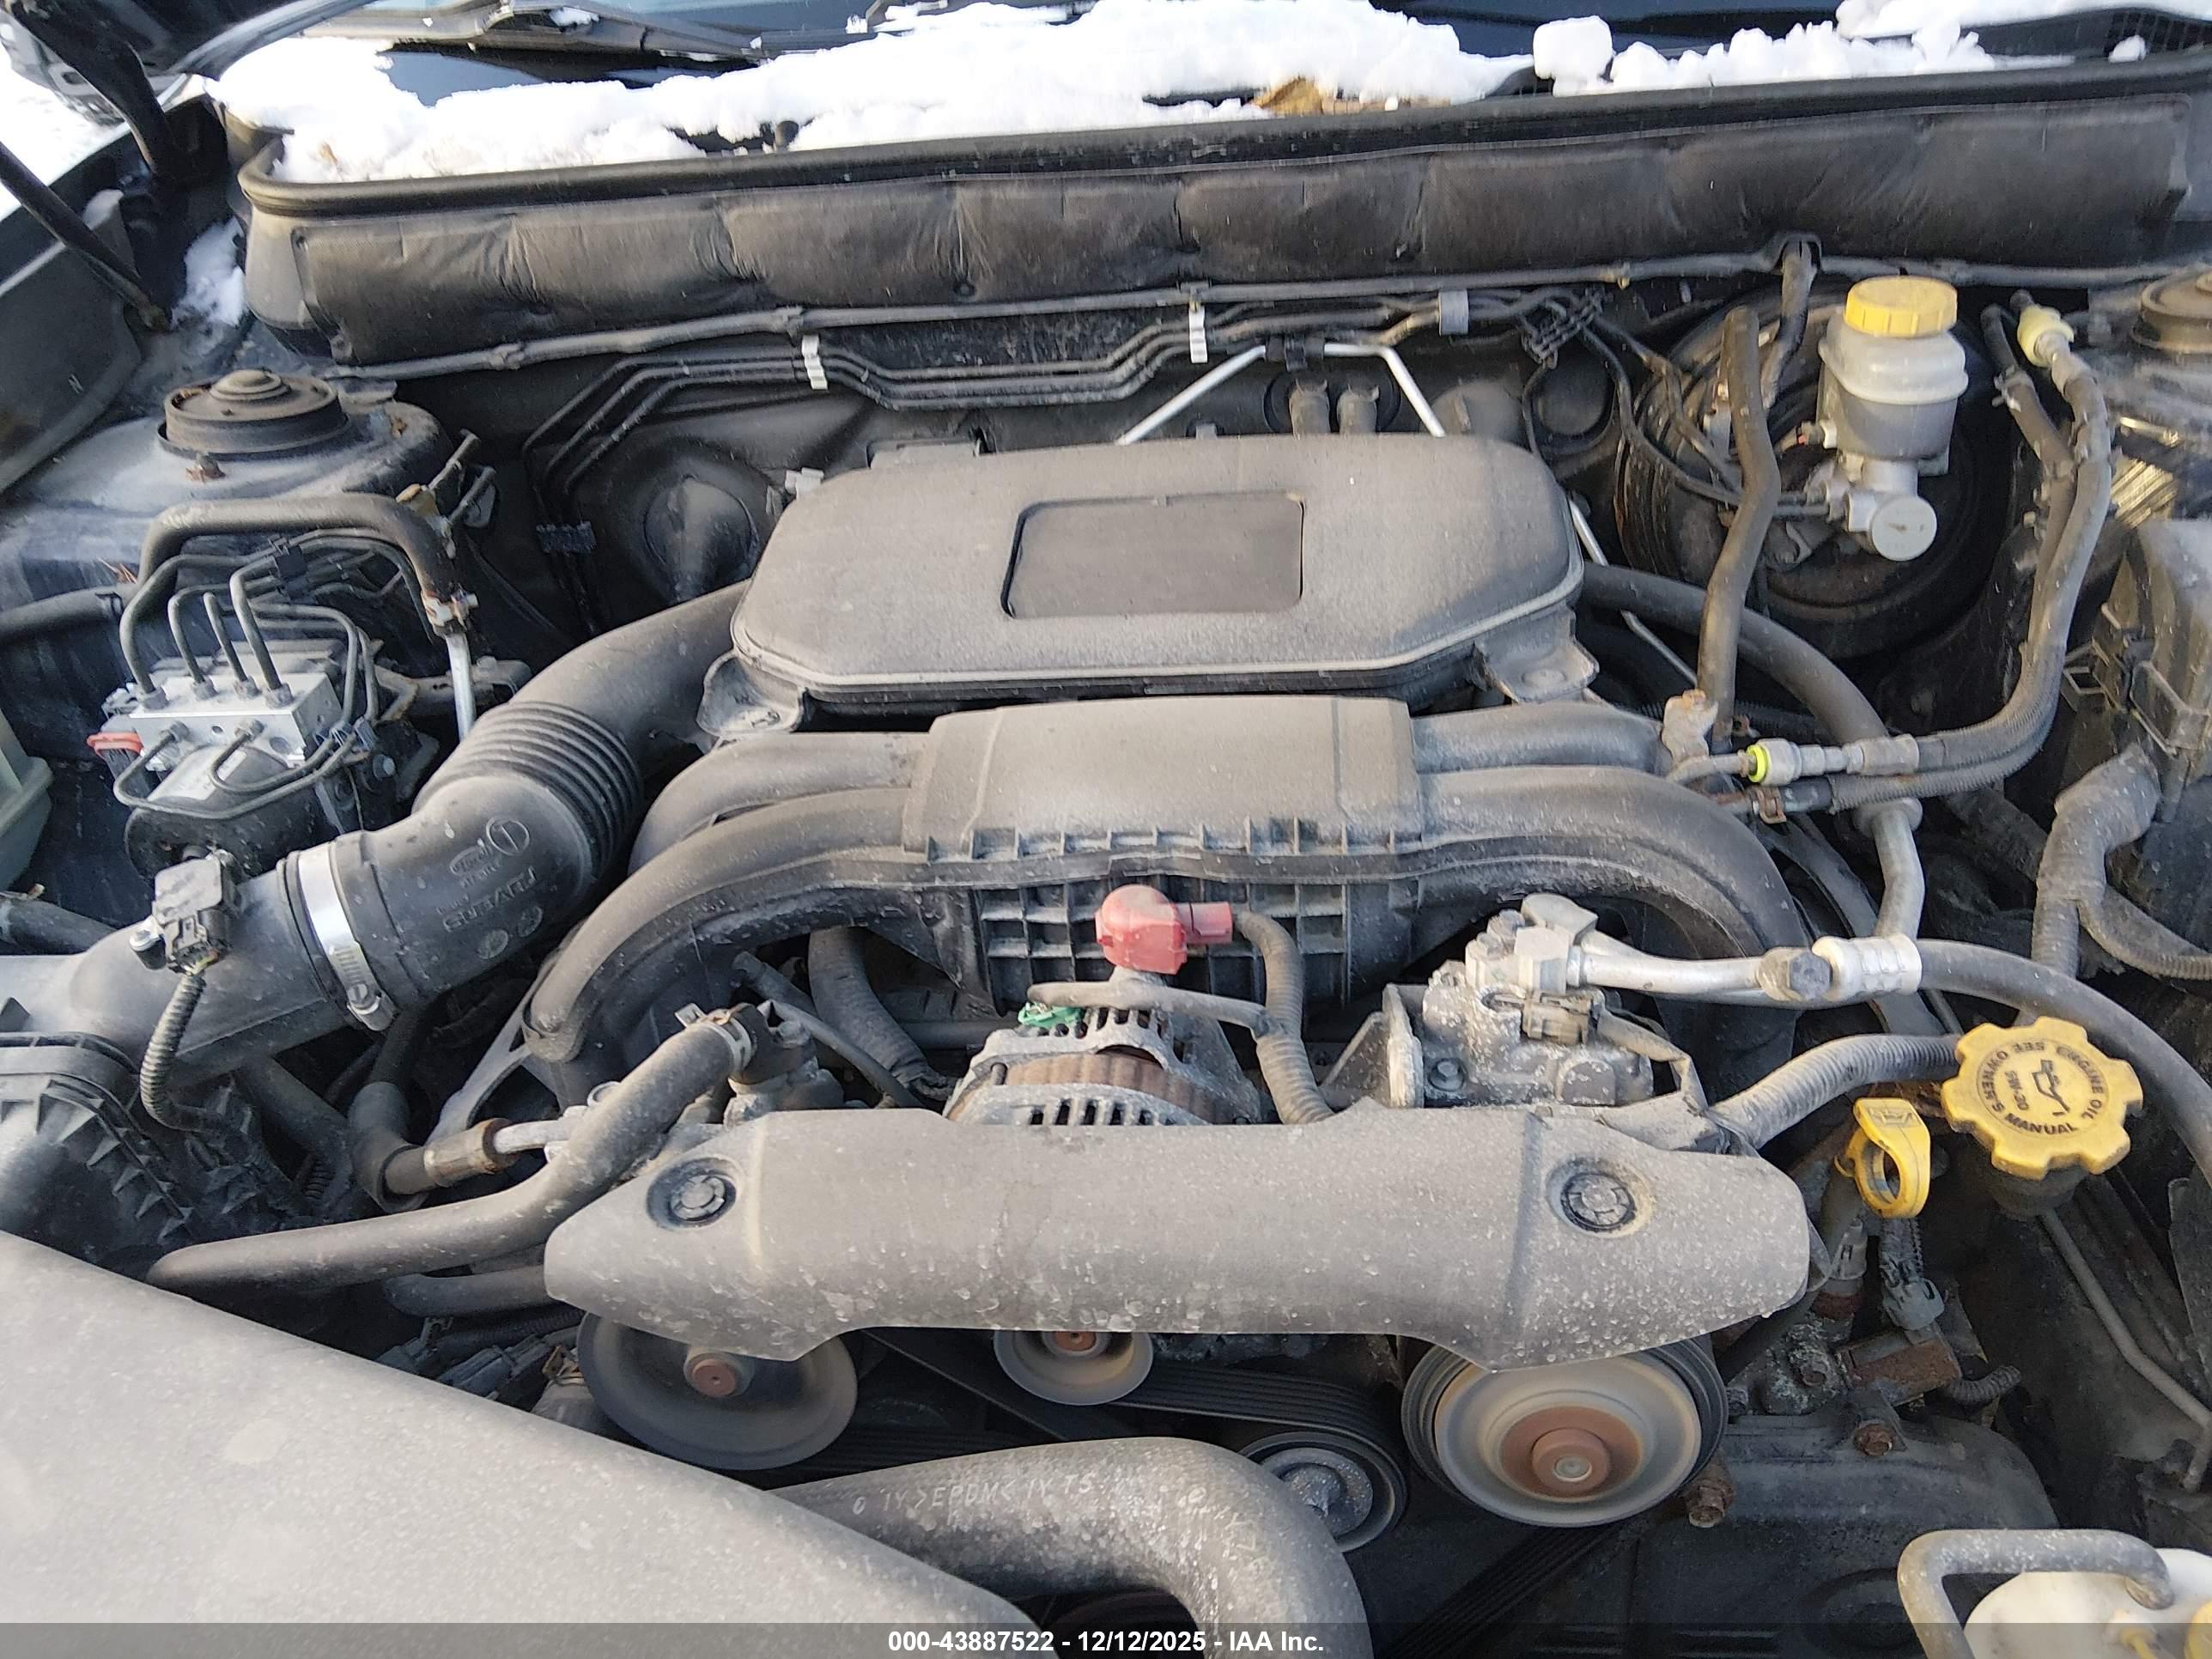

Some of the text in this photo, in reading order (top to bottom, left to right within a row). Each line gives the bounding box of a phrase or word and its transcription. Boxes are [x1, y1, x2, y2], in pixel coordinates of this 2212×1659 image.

[2012, 1042, 2045, 1054] SEE
[2057, 1045, 2104, 1120] ENGINE OIL
[2004, 1112, 2079, 1135] MANUAL
